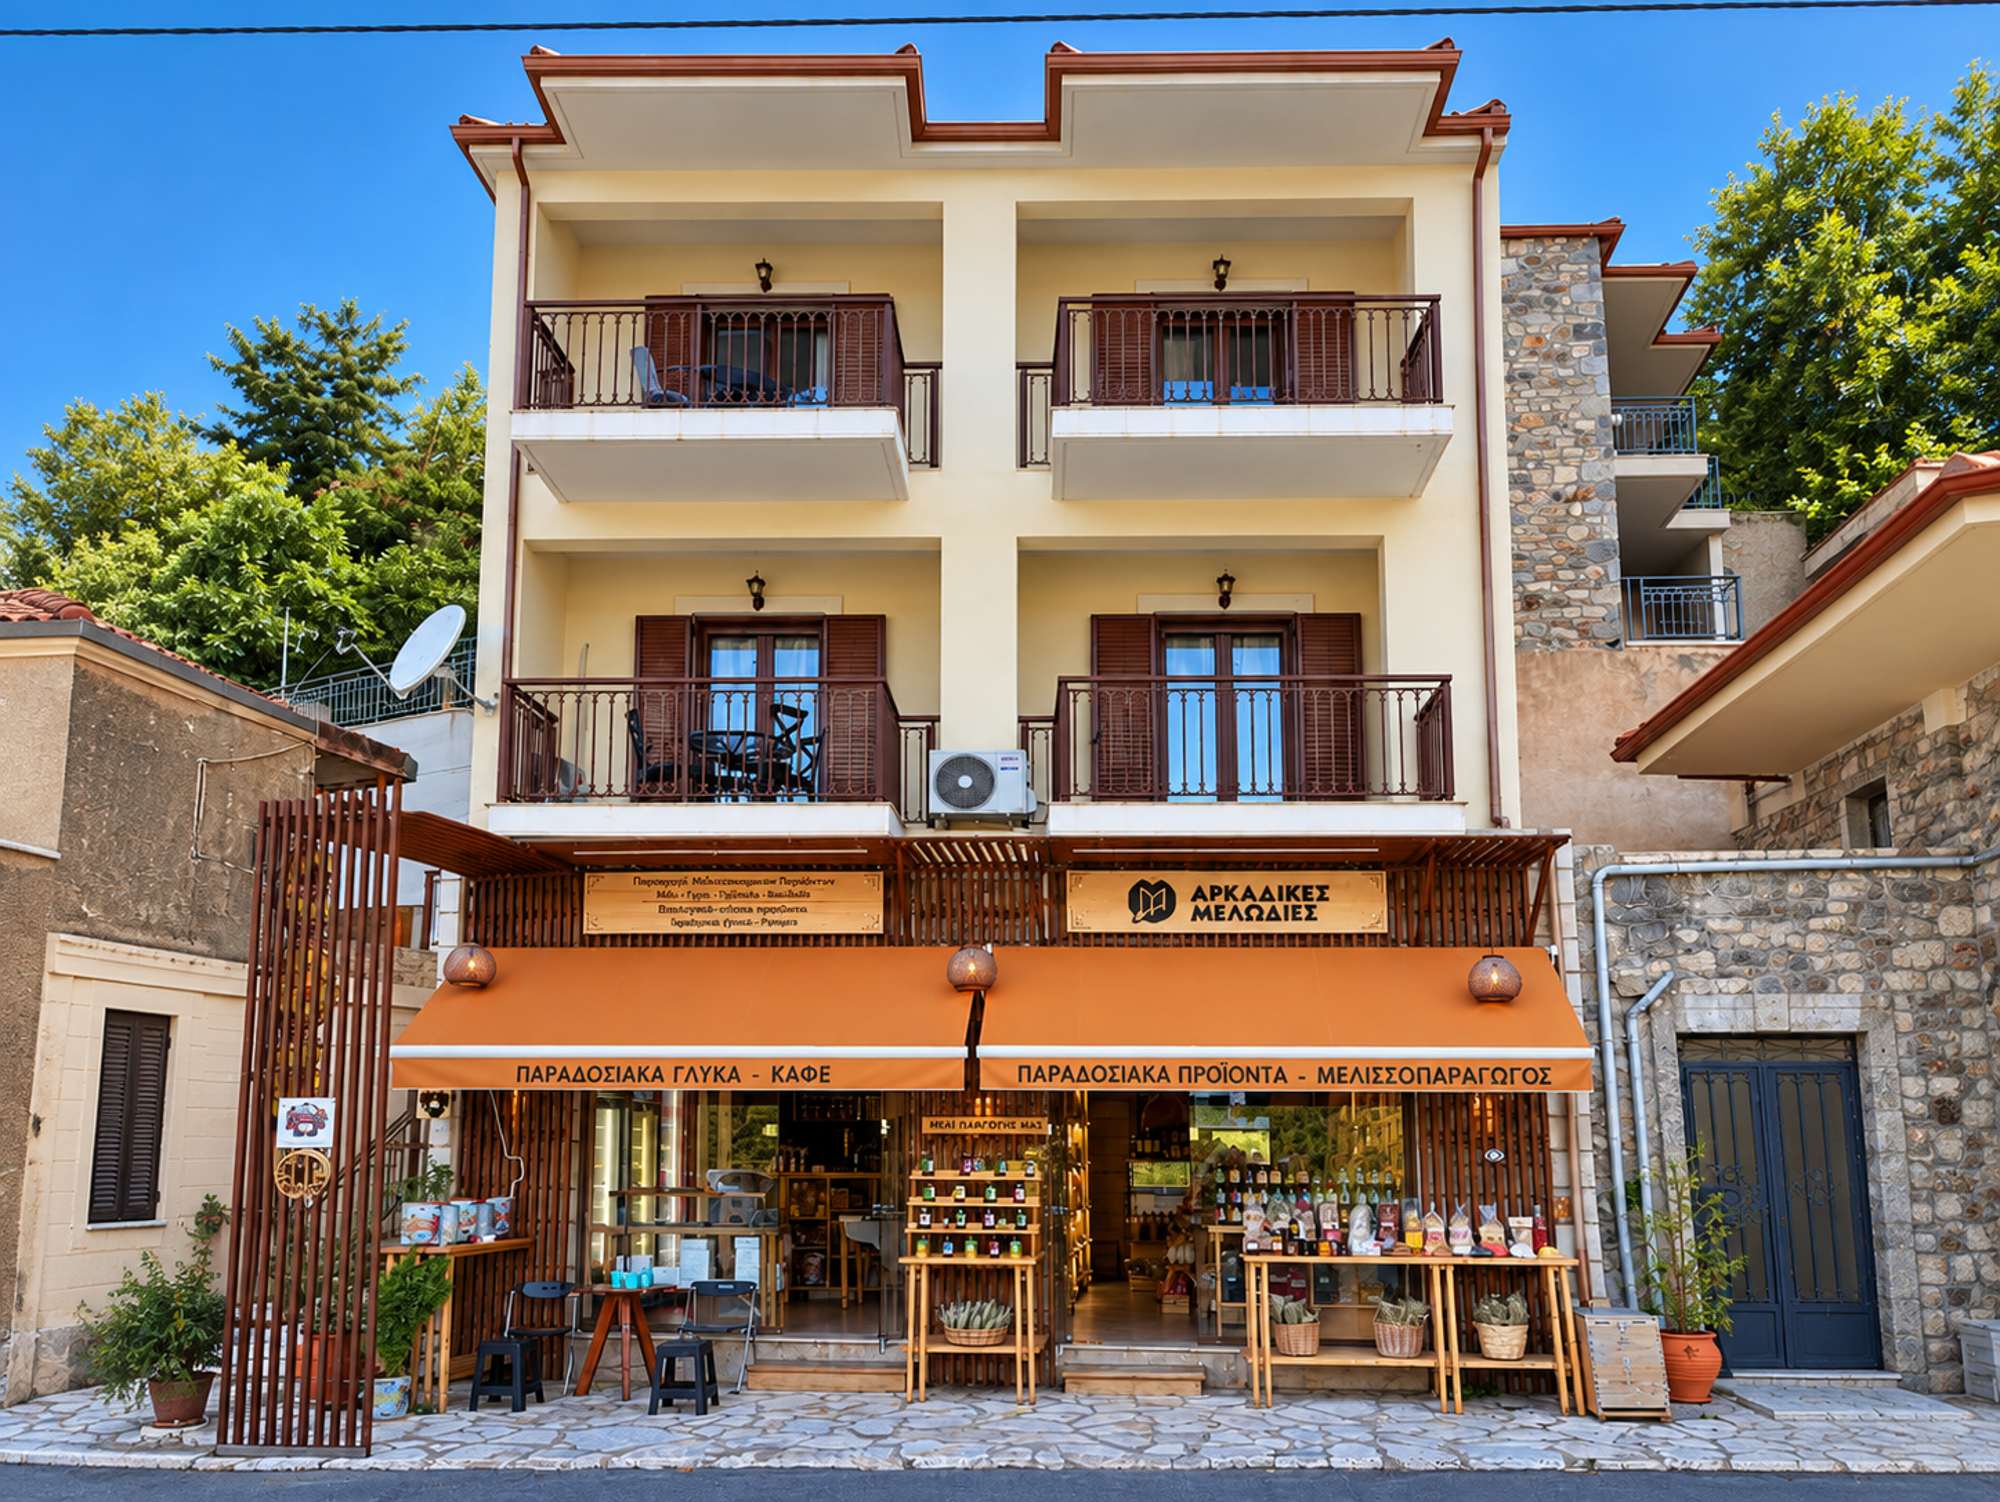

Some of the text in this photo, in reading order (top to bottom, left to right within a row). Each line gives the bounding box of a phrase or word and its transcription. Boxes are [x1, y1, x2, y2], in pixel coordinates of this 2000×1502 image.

[1190, 884, 1330, 902] ΑΡΚΑΔΙΚΕΣ
[1190, 904, 1318, 922] ΜΕΛΩΔΙΕΣ
[516, 1065, 665, 1083] ΠΑΡΑΔΟΣΙΑΚΑ
[672, 1065, 741, 1083] ΓΛΥΚΑ
[771, 1065, 832, 1083] ΚΑΦΕ
[1017, 1065, 1171, 1084] ΠΑΡΑΔΟΣΙΑΚΑ
[1178, 1062, 1289, 1084] ΠΡΟΪΟΝΤΑ
[1317, 1066, 1553, 1085] ΜΕΛΙΣΣΟΠΑΡΑΓΩΓΟΣ
